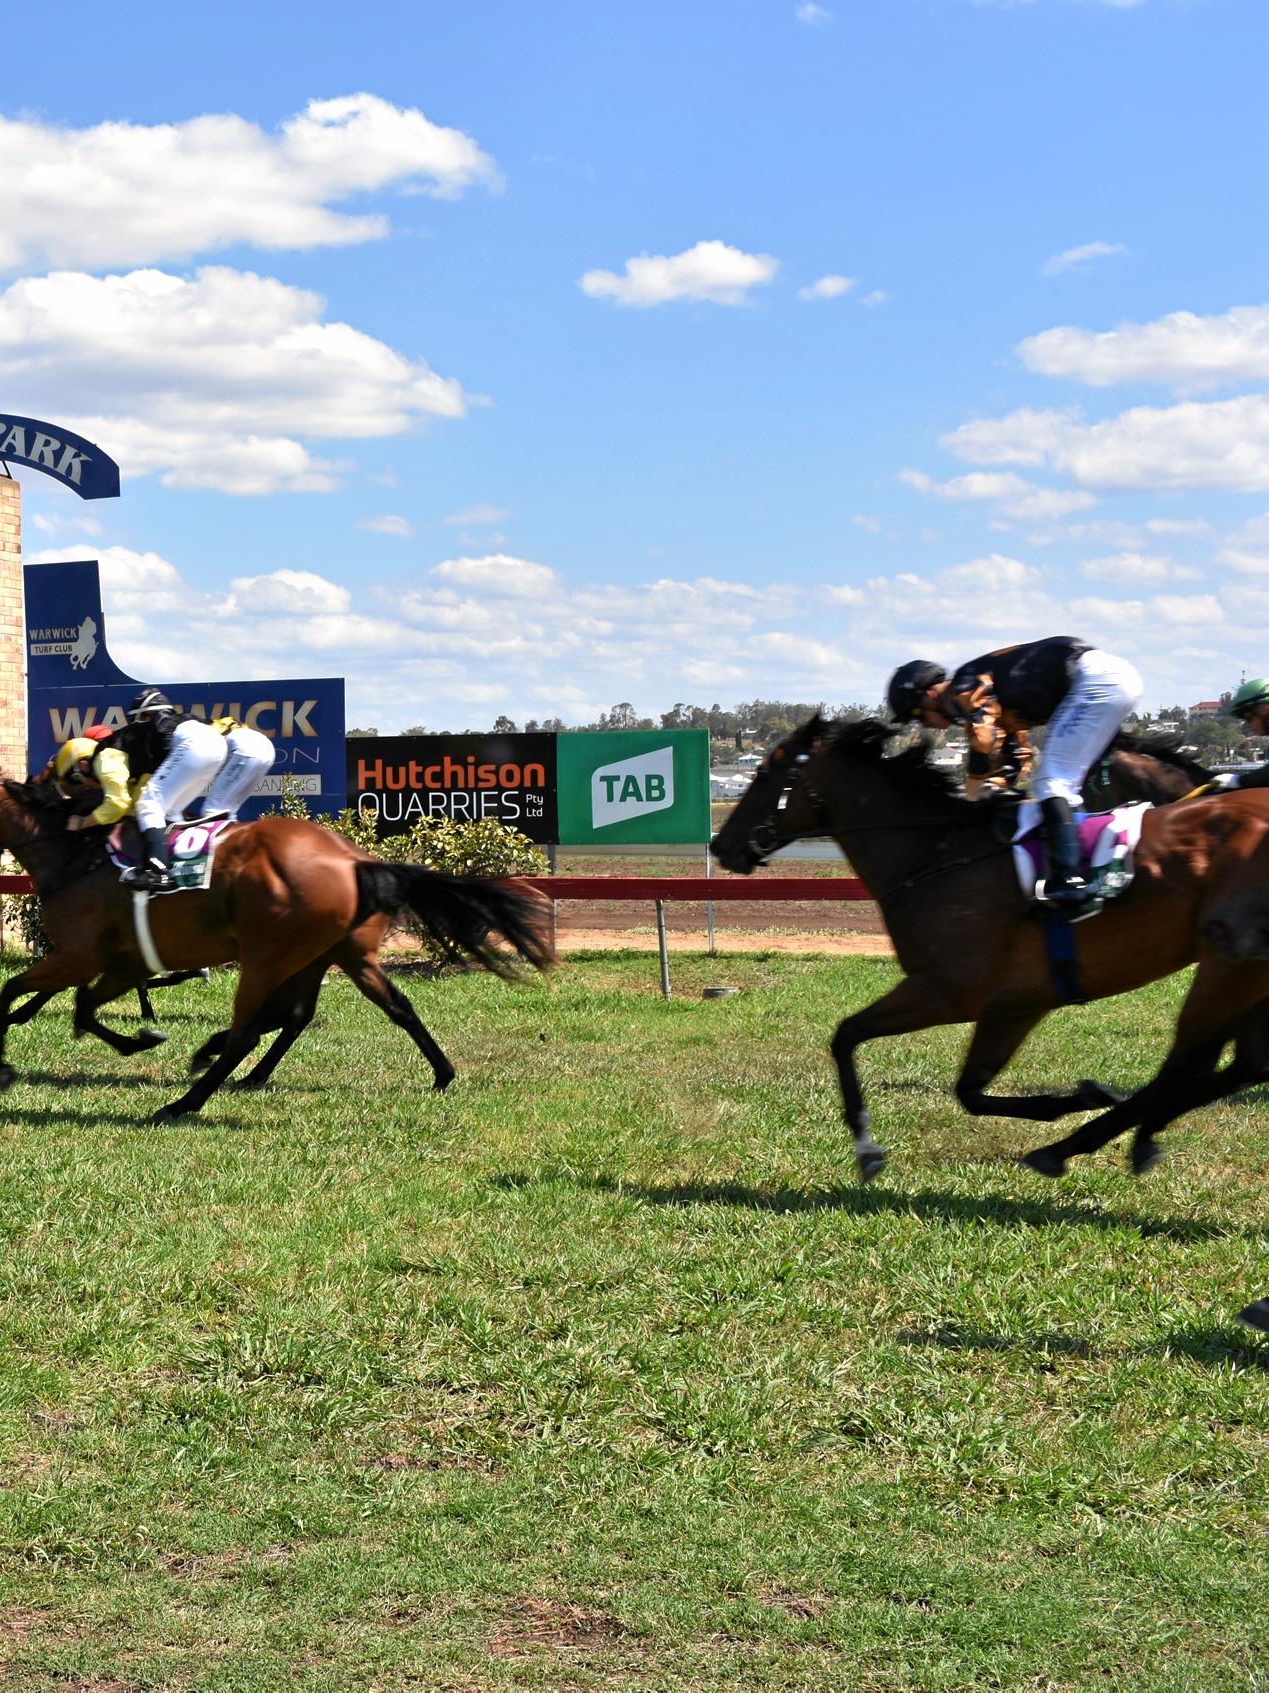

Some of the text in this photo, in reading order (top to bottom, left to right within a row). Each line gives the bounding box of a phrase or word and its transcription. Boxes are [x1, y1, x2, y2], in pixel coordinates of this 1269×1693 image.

[29, 627, 78, 640] WARWICK
[34, 644, 73, 654] TURF CLUB
[49, 700, 319, 743] WAICK
[357, 756, 546, 790] Hutchison
[253, 778, 317, 792] BANG
[599, 774, 666, 803] TAB
[358, 790, 521, 821] QUARRIES
[526, 794, 544, 806] Pty
[526, 807, 543, 818] Ltd
